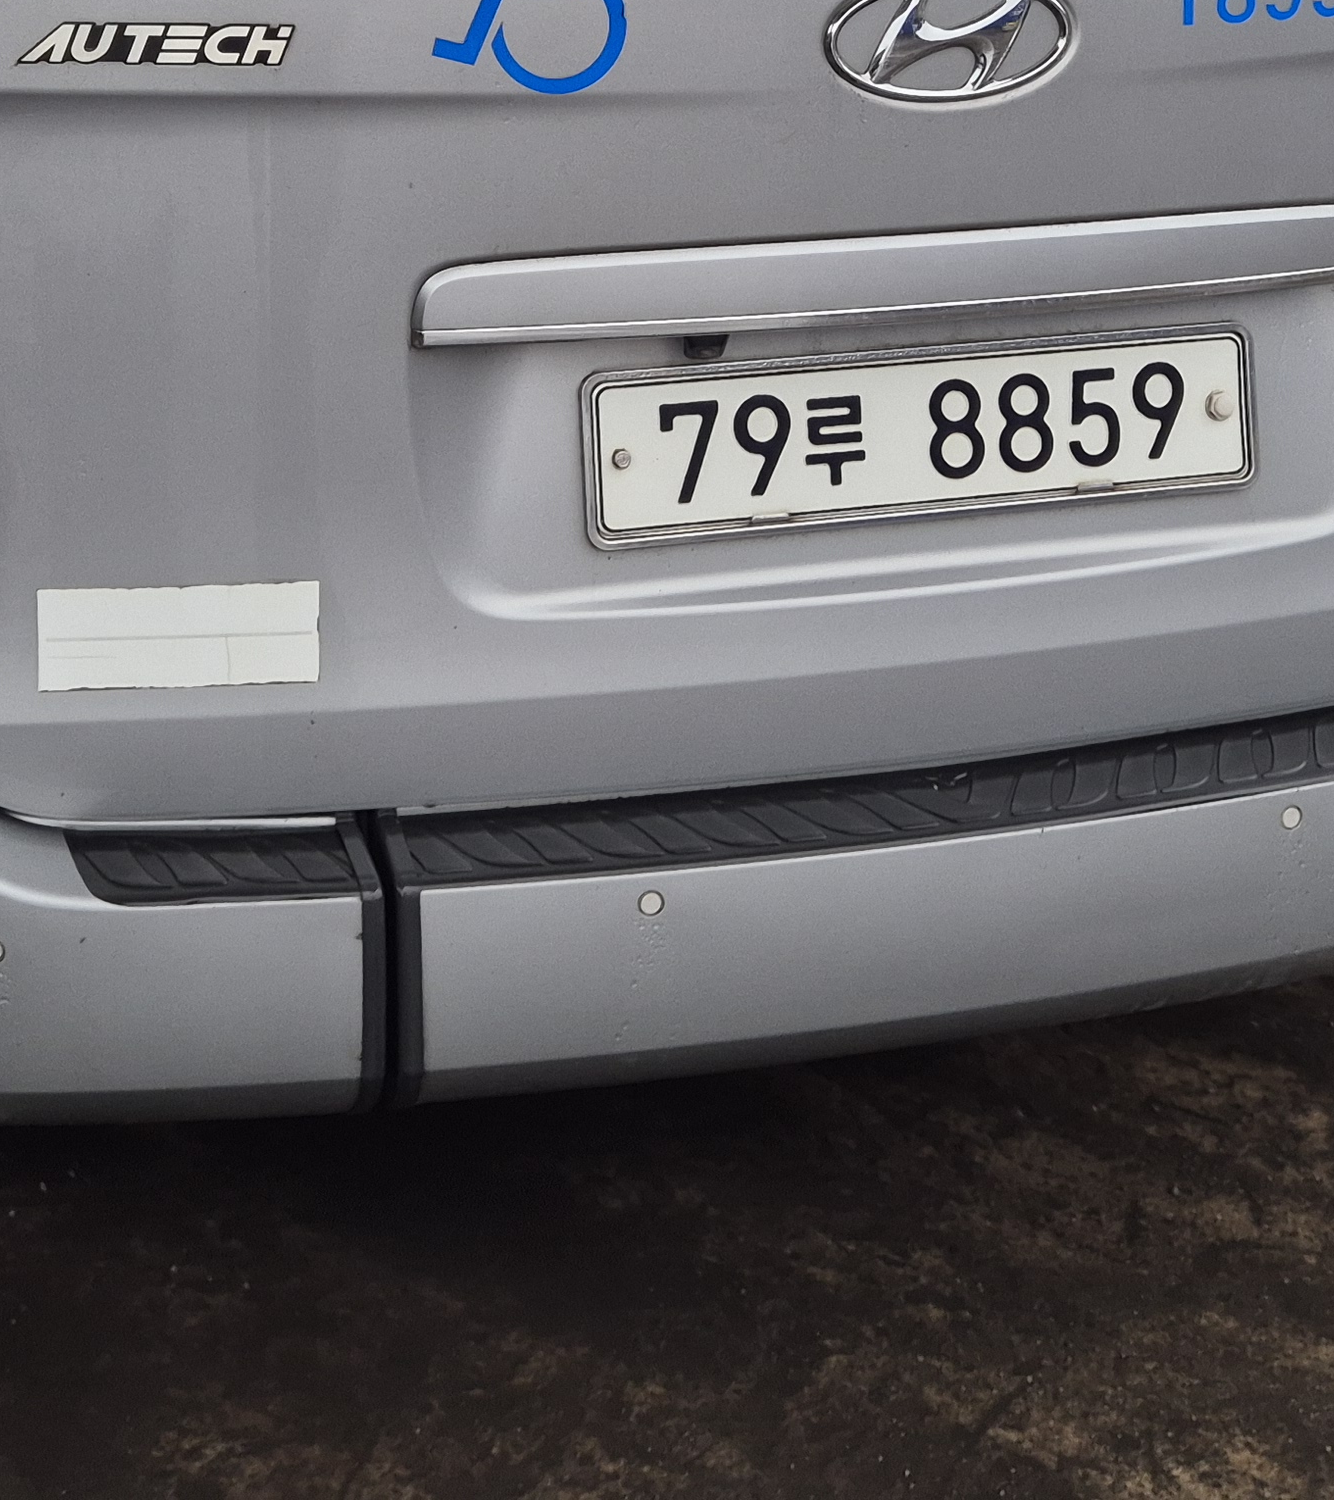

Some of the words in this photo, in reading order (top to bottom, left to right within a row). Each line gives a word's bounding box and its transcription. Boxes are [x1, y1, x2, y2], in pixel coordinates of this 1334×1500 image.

[16, 21, 296, 67] AUTECH
[658, 393, 866, 504] 79루
[928, 361, 1185, 479] 8859
